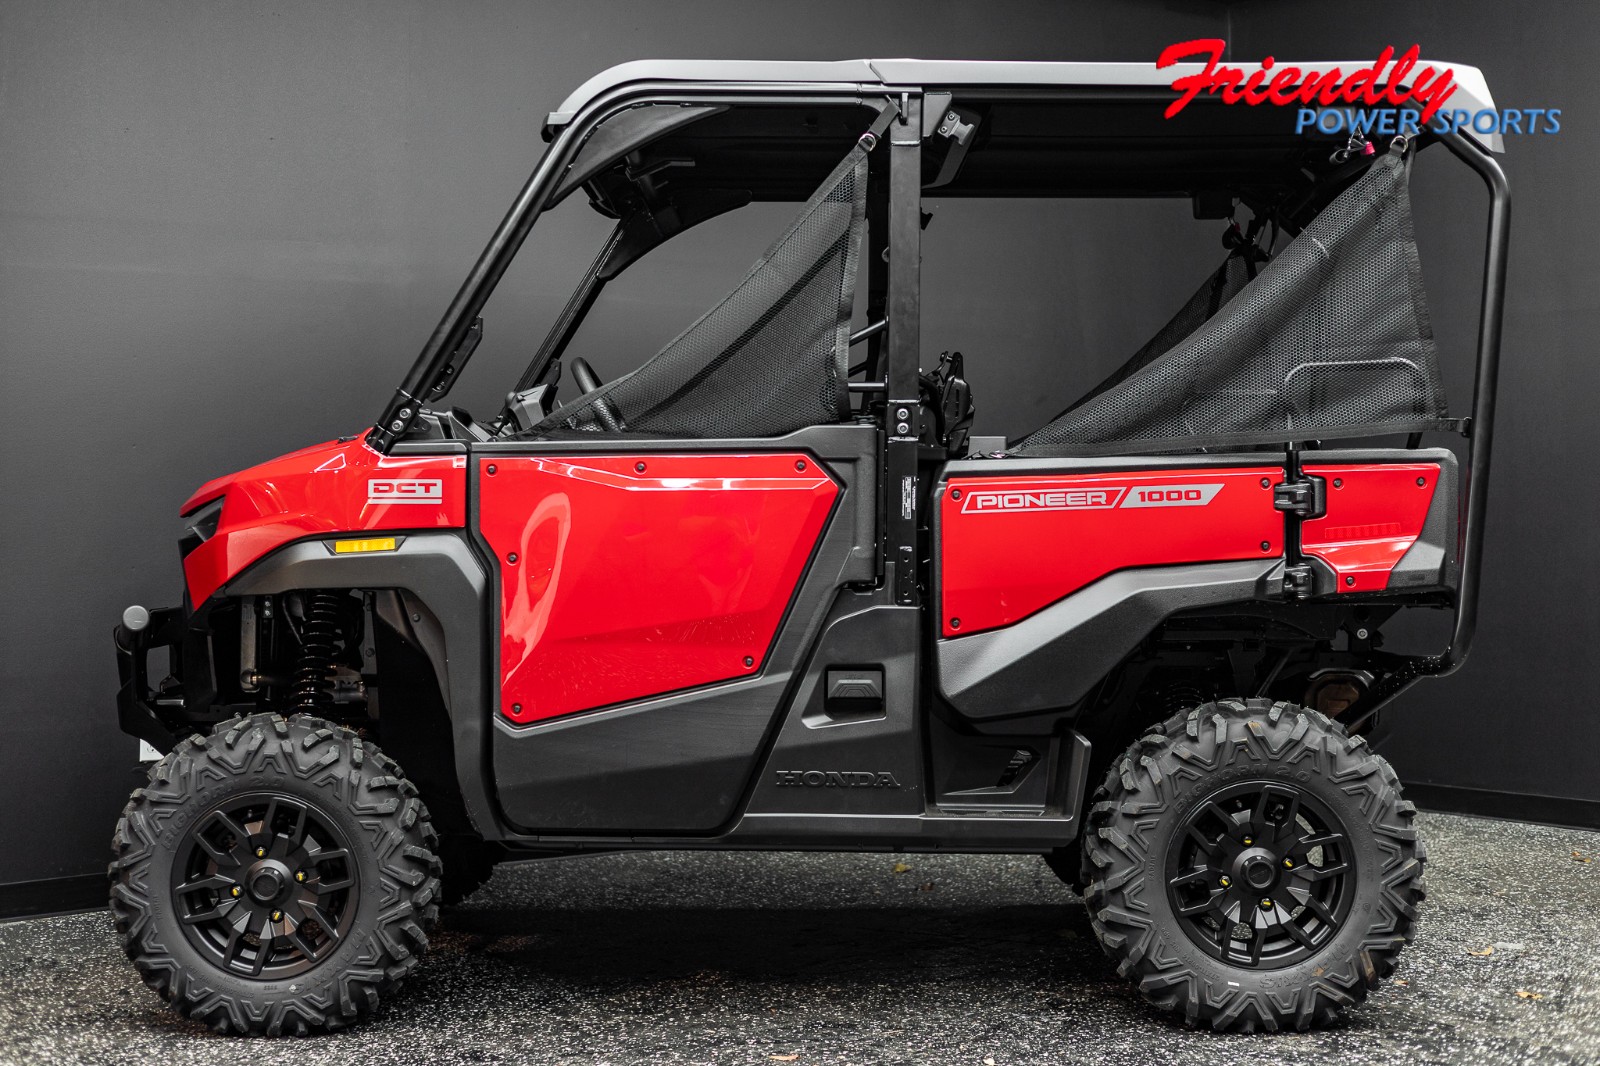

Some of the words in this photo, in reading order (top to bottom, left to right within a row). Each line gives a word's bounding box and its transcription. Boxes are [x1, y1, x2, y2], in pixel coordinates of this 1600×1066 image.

[373, 482, 438, 494] DCT
[976, 490, 1107, 510] PIONEER
[1137, 488, 1203, 503] 1000
[775, 770, 901, 789] HONDA
[1274, 765, 1312, 784] 2.0
